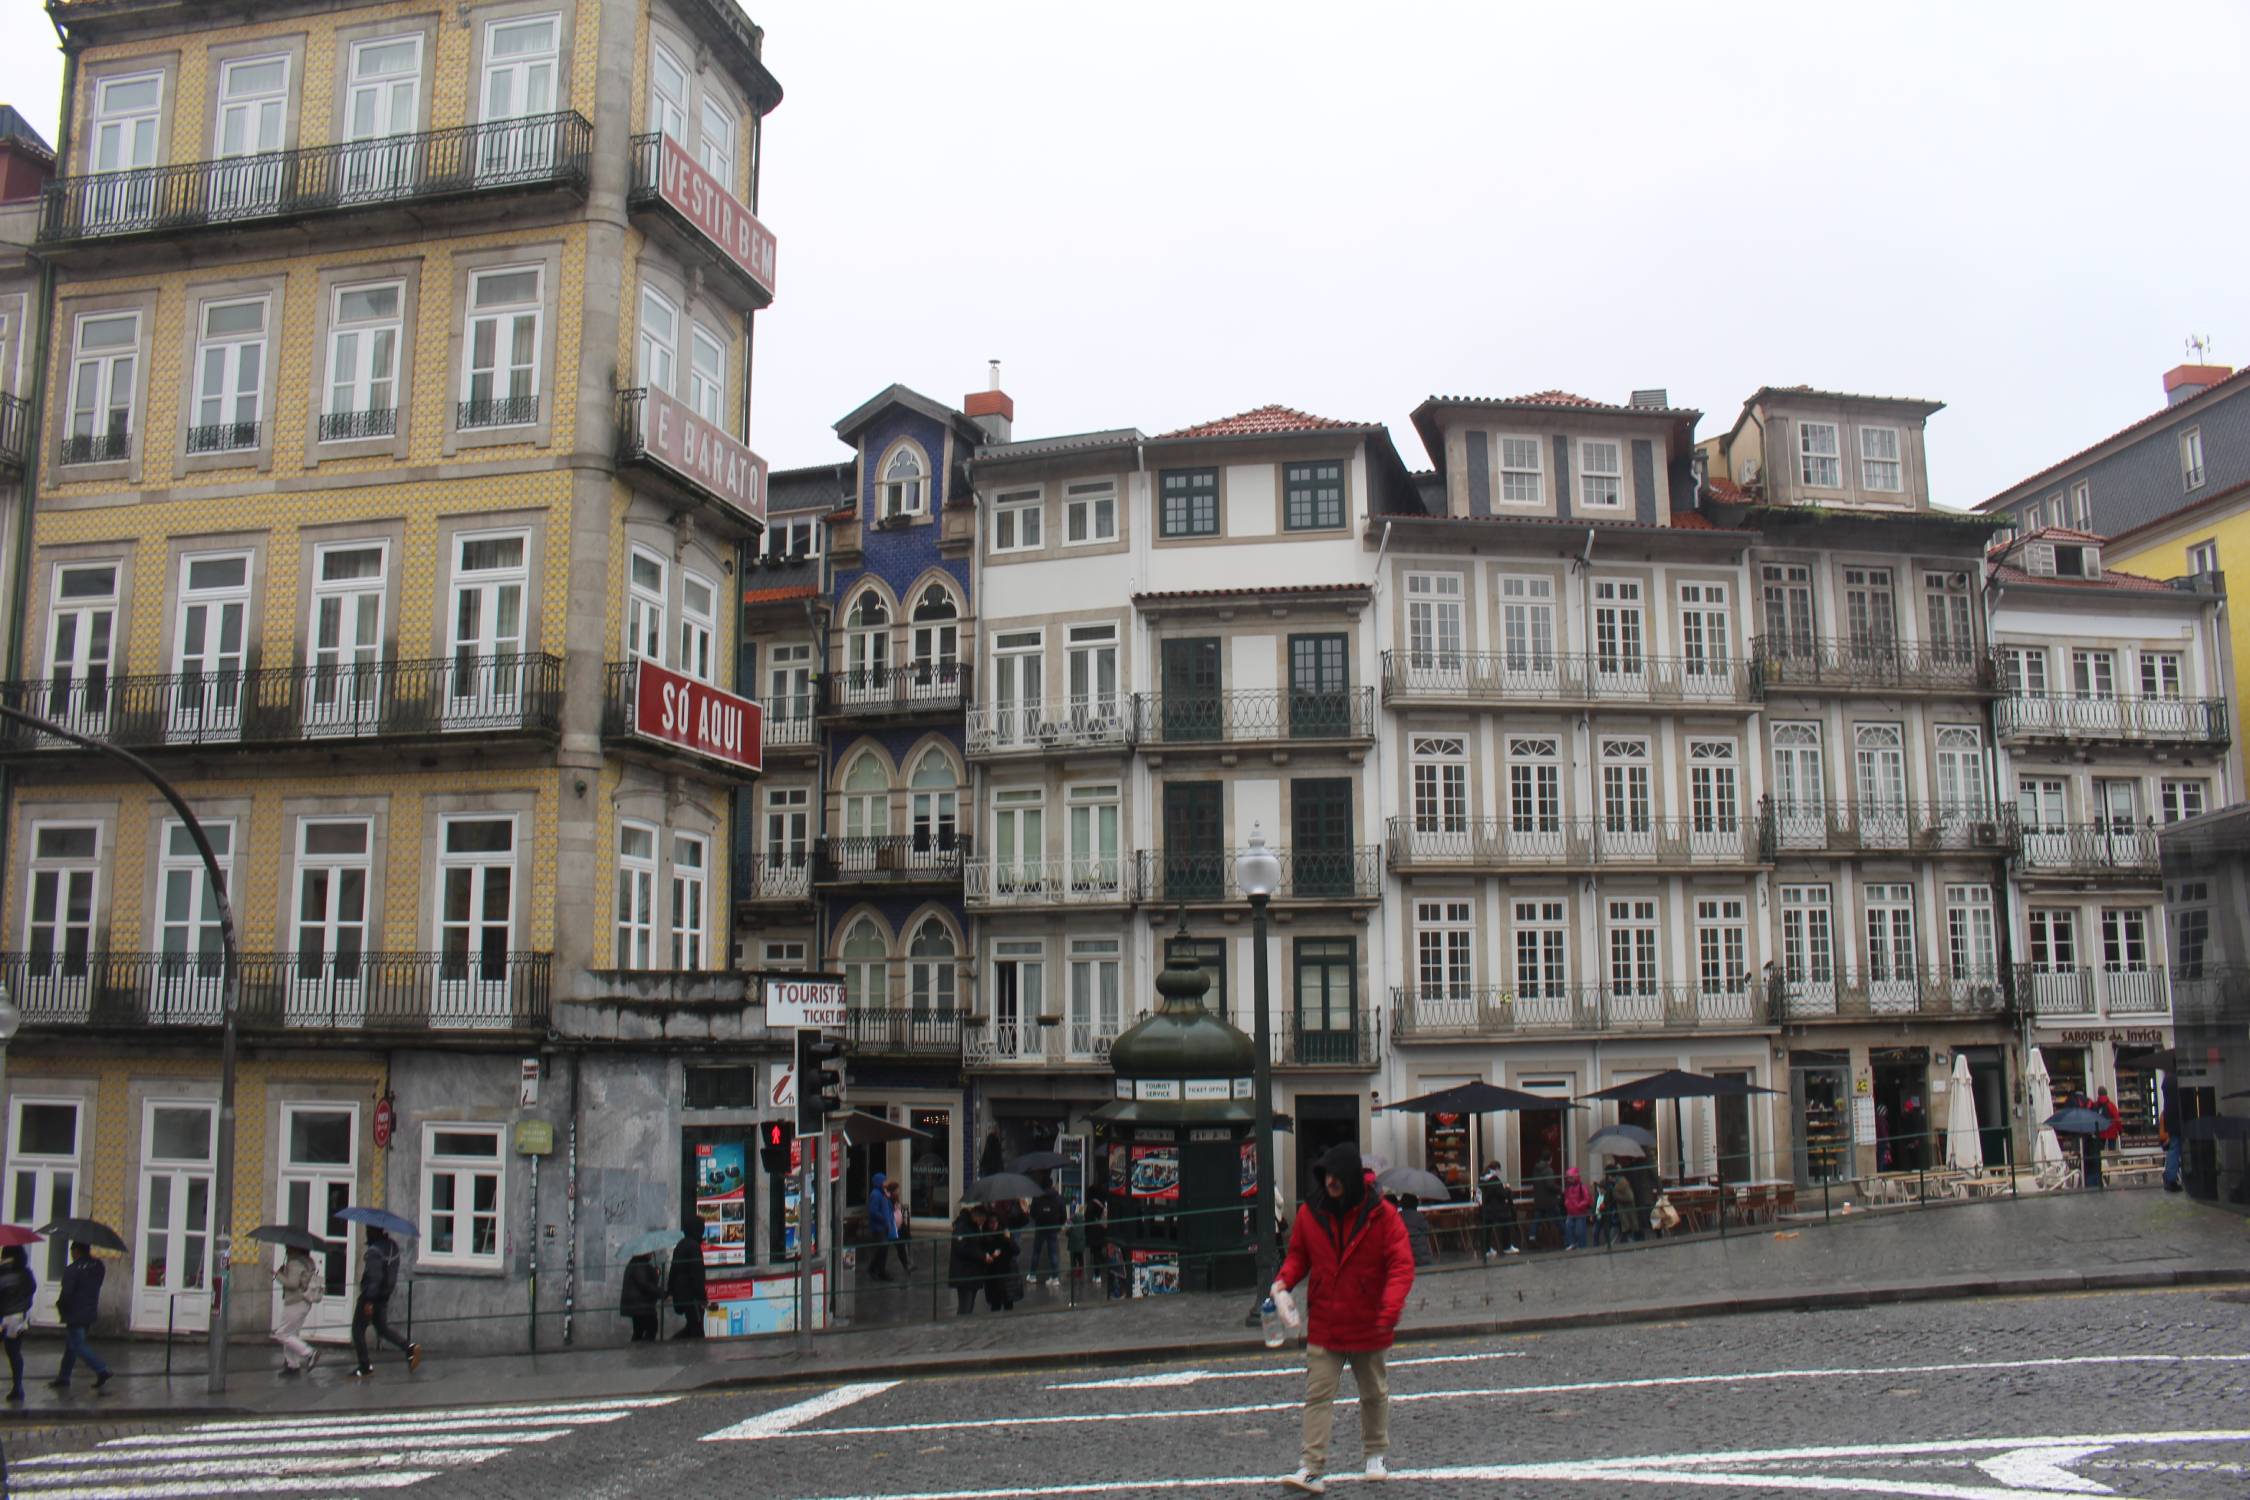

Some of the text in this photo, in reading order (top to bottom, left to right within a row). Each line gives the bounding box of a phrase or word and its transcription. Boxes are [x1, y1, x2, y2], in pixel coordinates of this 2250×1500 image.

[664, 146, 773, 281] VESTIR BEM
[658, 403, 758, 506] E BARATO
[662, 681, 743, 753] SÓ AQUI
[775, 983, 835, 1004] TOURIST
[803, 1009, 835, 1024] TICKET
[2061, 1030, 2106, 1042] SABORES
[2127, 1028, 2162, 1041] Invicta
[1145, 1082, 1171, 1090] TOURIST
